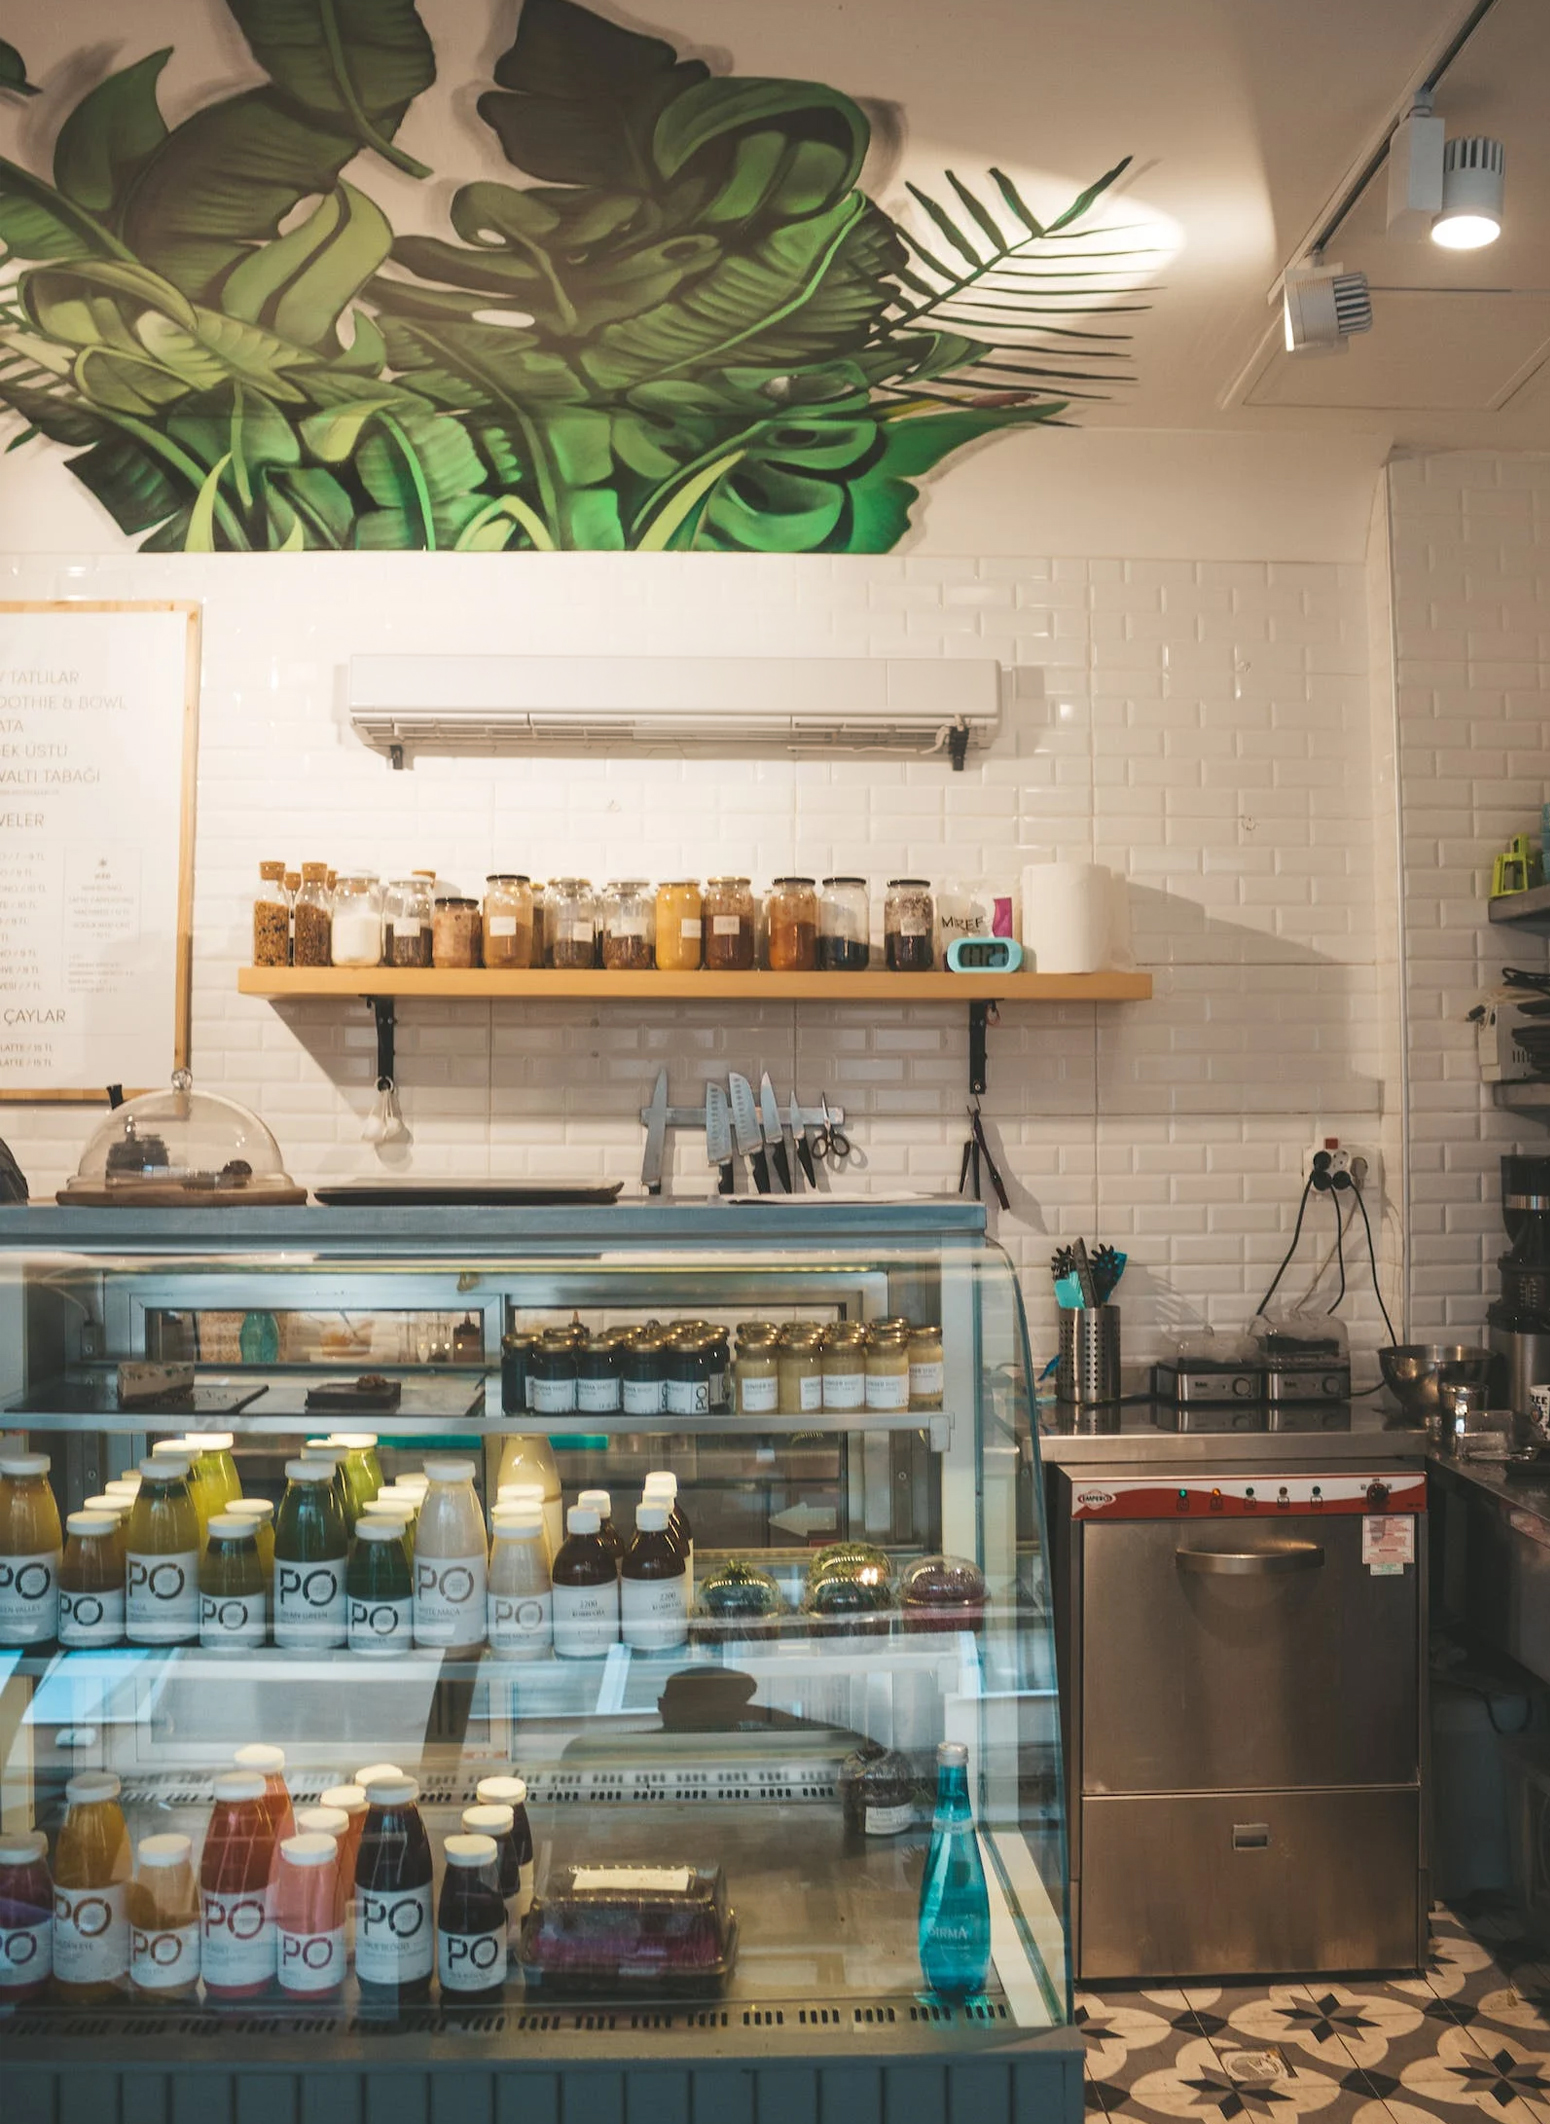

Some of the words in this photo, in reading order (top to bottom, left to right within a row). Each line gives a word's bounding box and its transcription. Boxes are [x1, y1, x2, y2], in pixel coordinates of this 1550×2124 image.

[10, 669, 80, 686] TATLILAR
[79, 696, 127, 711] BOWL
[3, 1008, 67, 1026] ÇAYLAR
[0, 1562, 51, 1600] PO
[128, 1560, 185, 1600] PO
[279, 1567, 338, 1607] PO
[417, 1564, 475, 1604] PO
[58, 1593, 104, 1627] PO
[201, 1598, 249, 1631] PO
[351, 1602, 400, 1636] PO
[495, 1599, 543, 1631] PO
[54, 1890, 113, 1938] PO
[205, 1897, 266, 1940] PO
[363, 1895, 424, 1938] PO
[132, 1929, 183, 1966] PO
[283, 1934, 334, 1970] PO
[447, 1935, 499, 1970] PO
